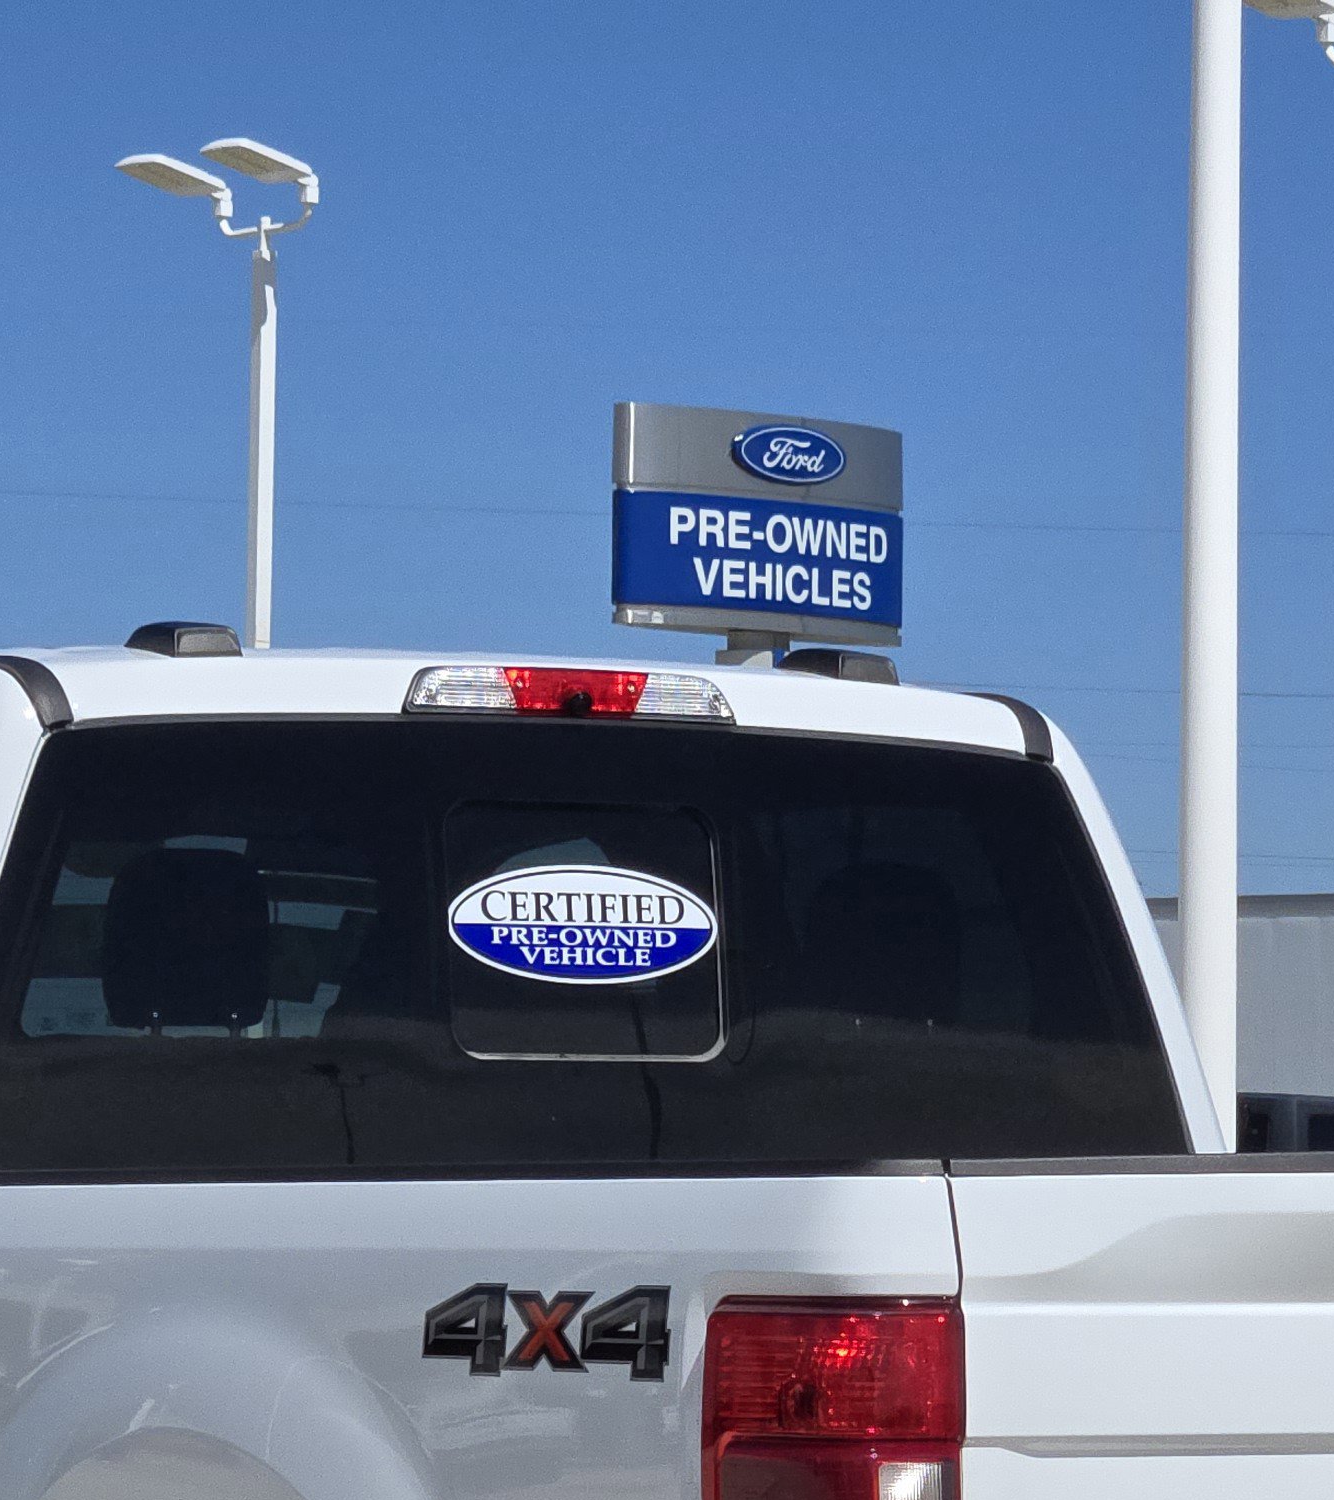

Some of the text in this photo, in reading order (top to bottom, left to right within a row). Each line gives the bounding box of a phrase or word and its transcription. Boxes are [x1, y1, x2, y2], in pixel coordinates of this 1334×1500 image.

[762, 436, 826, 473] Ford
[669, 506, 888, 564] PRE-OWNED
[693, 556, 872, 611] VEHICLES
[480, 890, 685, 925] CERTIFIED
[490, 926, 677, 948] PRE-OWNED
[519, 947, 652, 966] VEHICLE
[422, 1283, 672, 1382] 4X4
